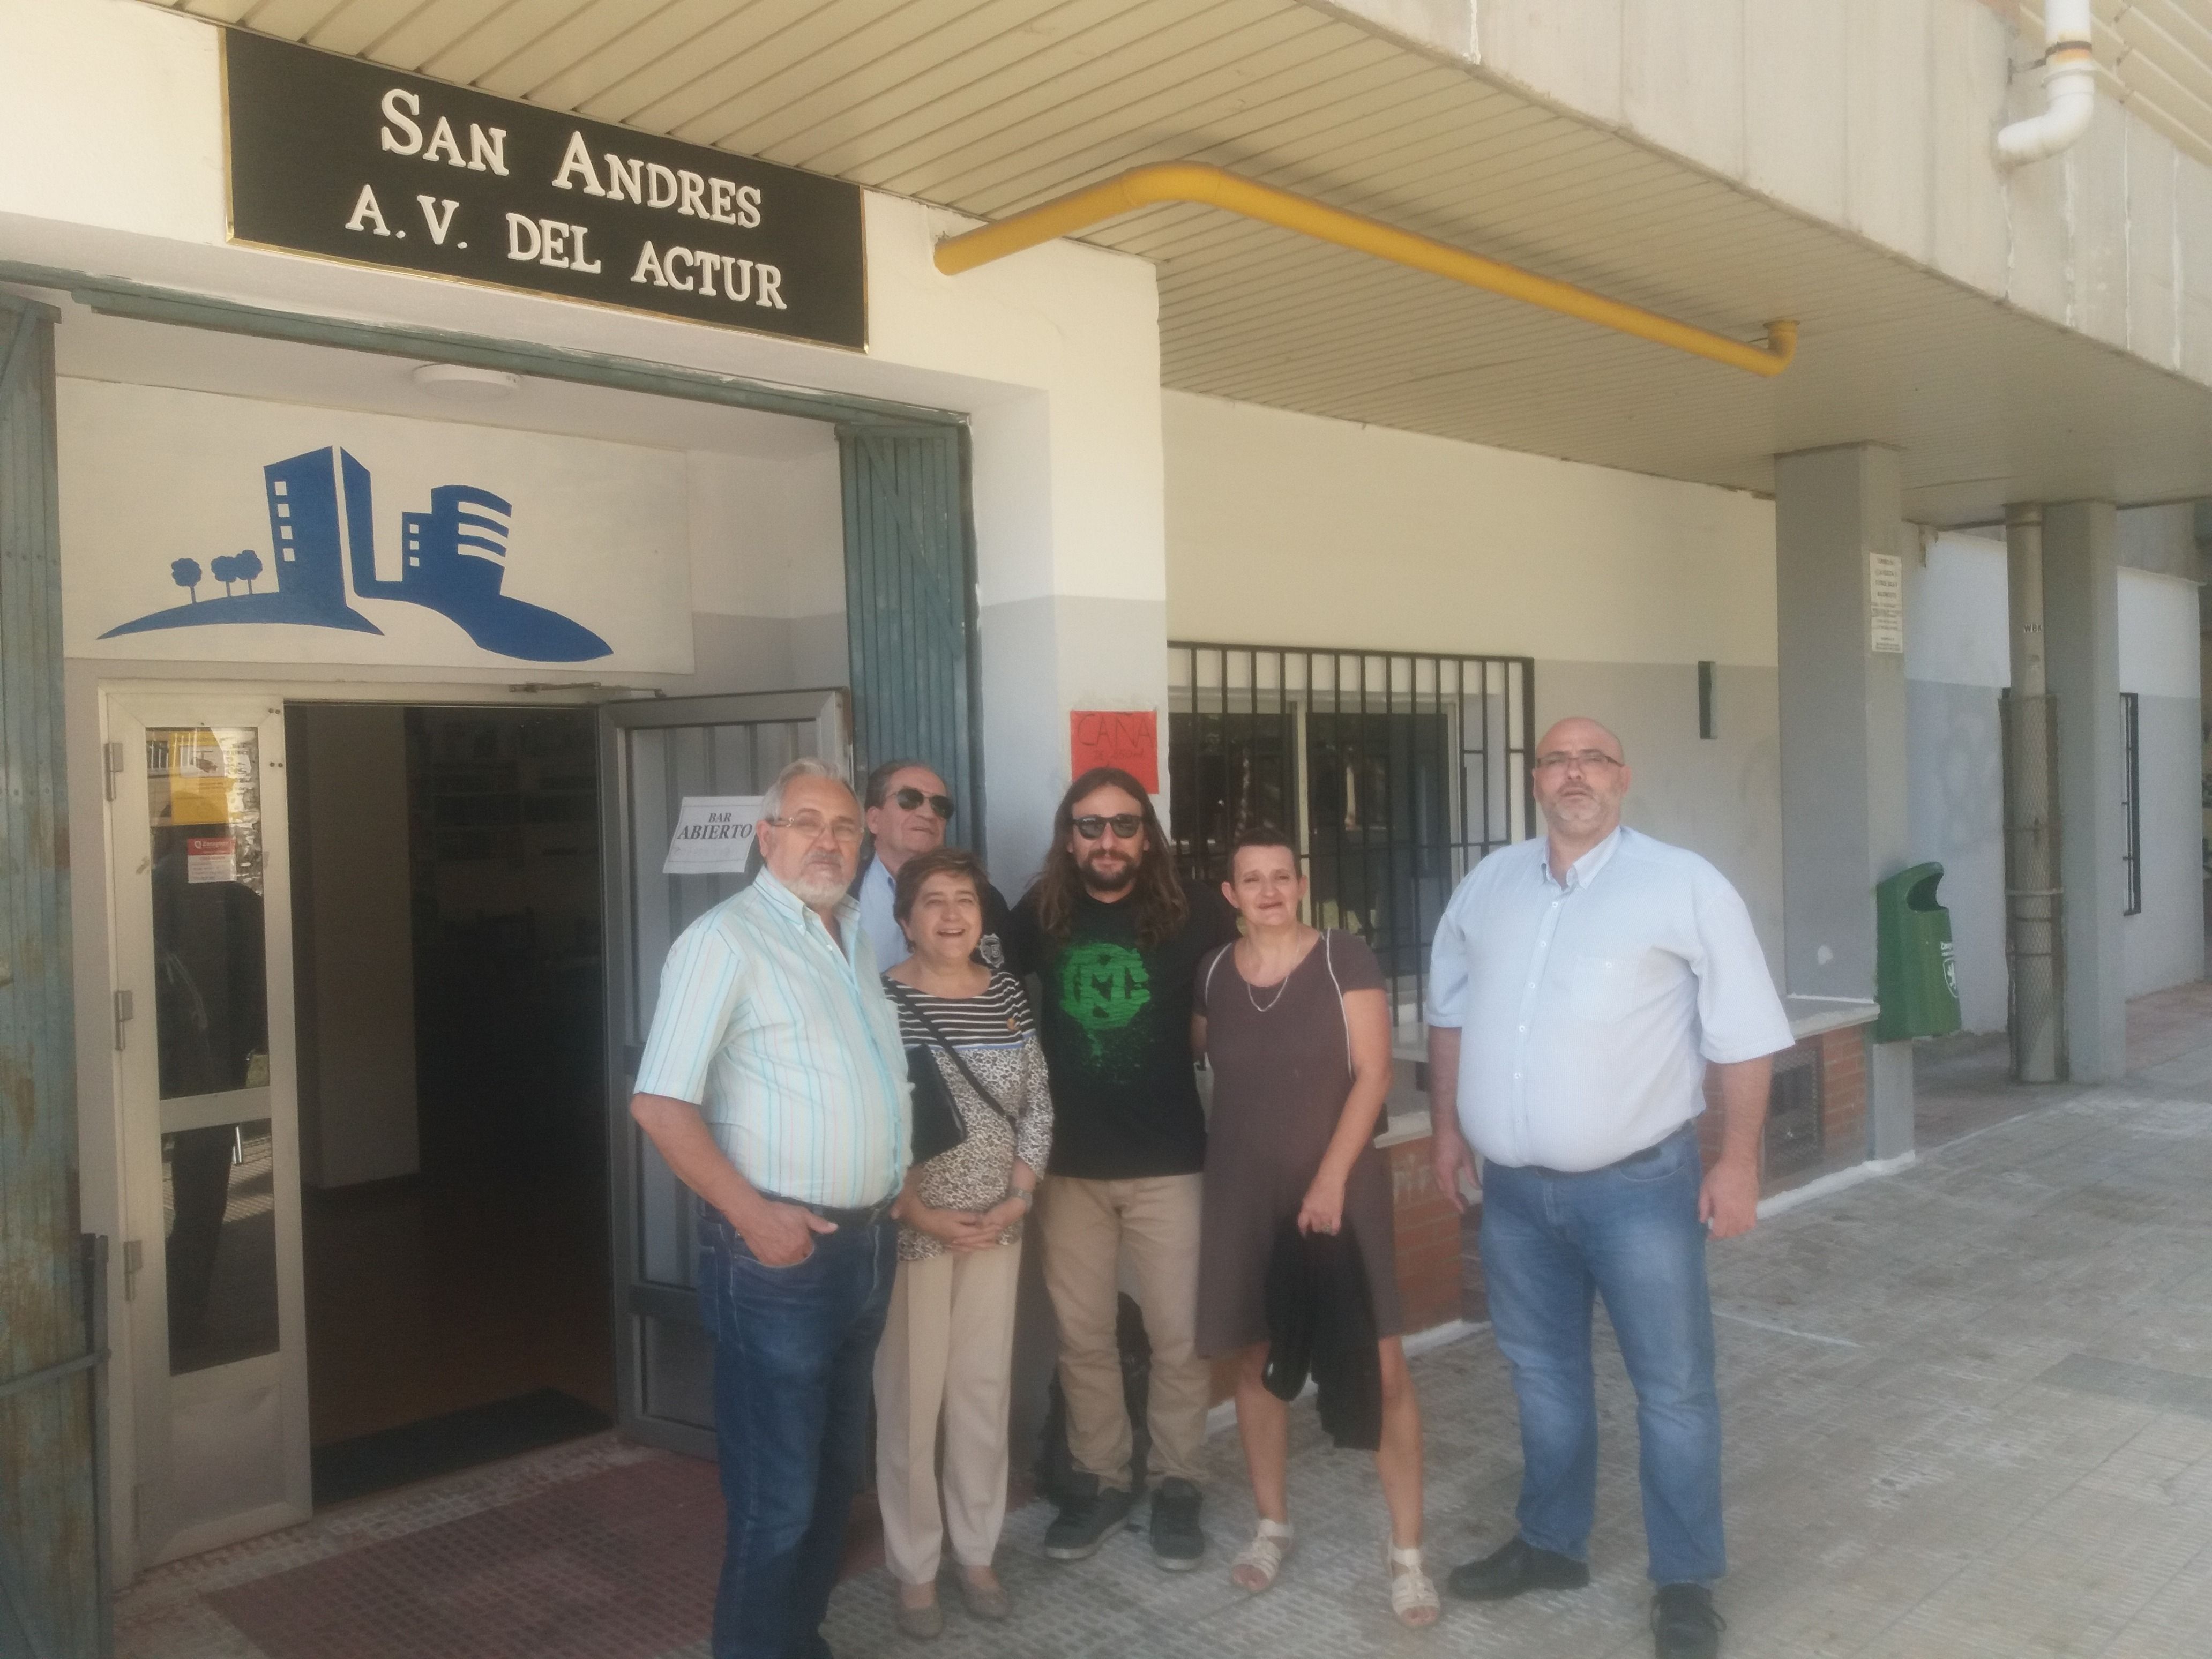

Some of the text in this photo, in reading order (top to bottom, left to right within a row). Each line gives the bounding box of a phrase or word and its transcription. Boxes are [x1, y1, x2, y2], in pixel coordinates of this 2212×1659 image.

[380, 88, 762, 228] SAN ANDRES
[505, 212, 602, 274] DEL
[630, 240, 788, 309] ACTUR
[677, 824, 753, 840] ABIERTO
[708, 812, 732, 823] BAR
